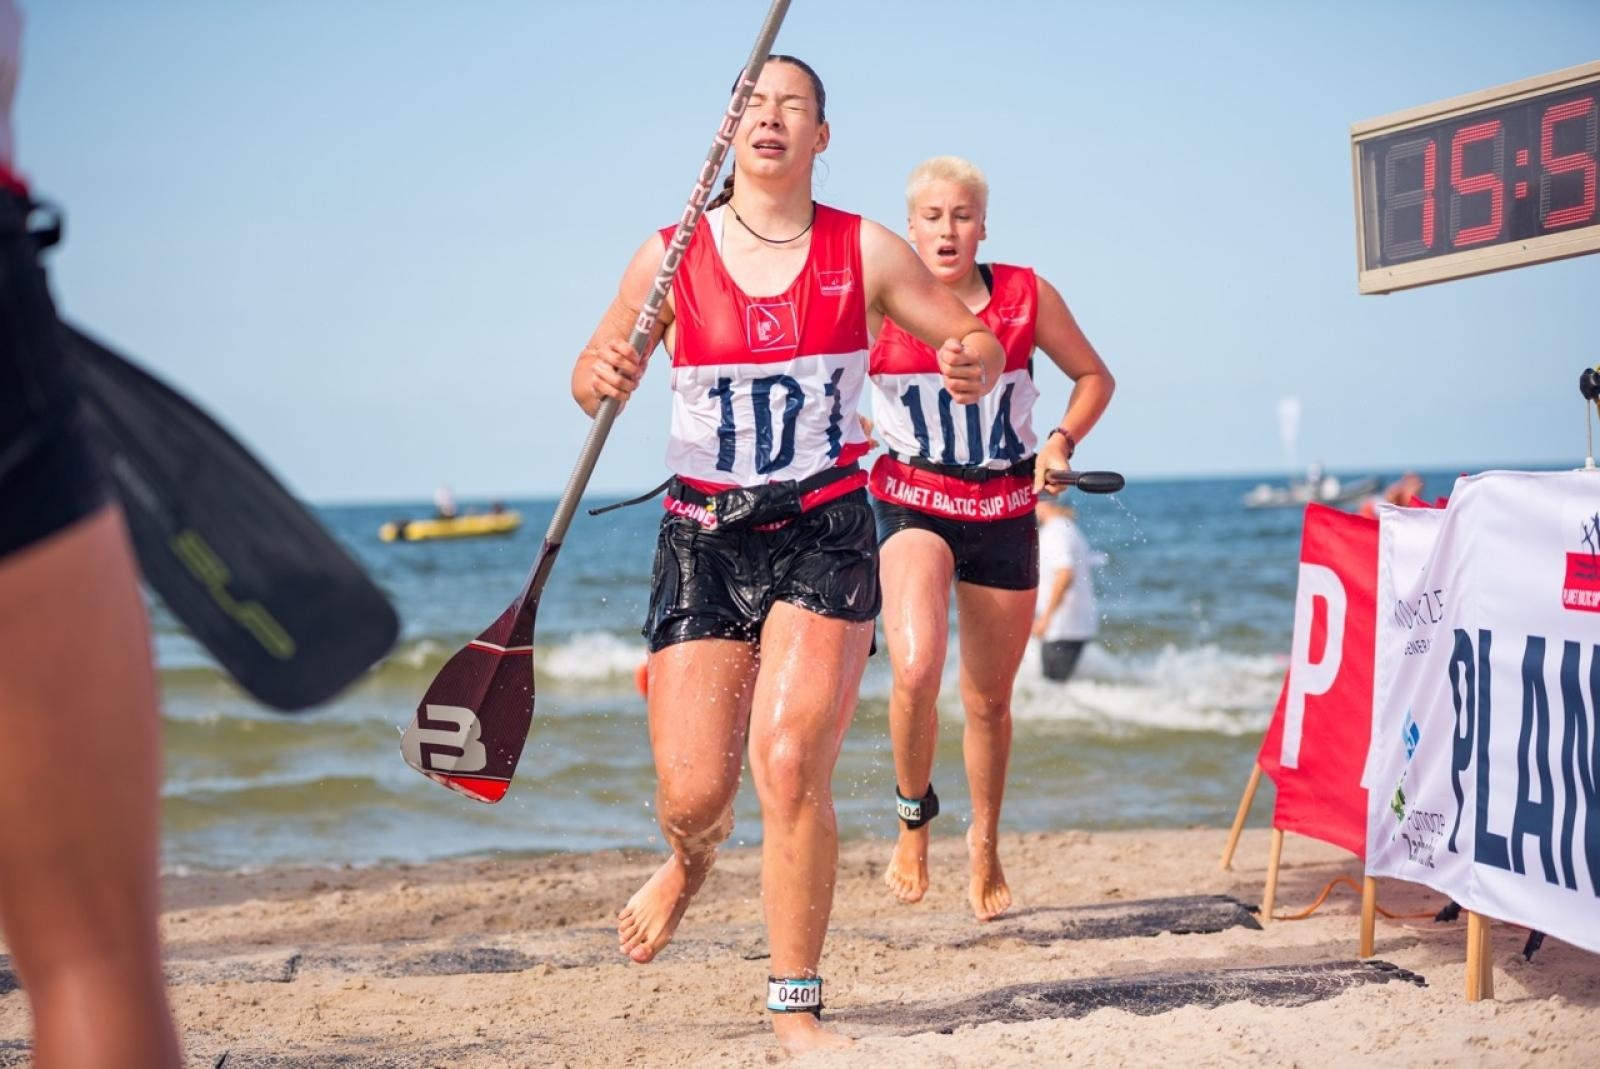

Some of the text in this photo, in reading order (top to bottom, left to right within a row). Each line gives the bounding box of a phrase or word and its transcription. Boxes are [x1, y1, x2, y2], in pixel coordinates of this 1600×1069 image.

[884, 475, 931, 507] PLANET
[931, 491, 977, 517] BALTIC
[978, 494, 1004, 518] SUP
[778, 986, 817, 1004] 0401
